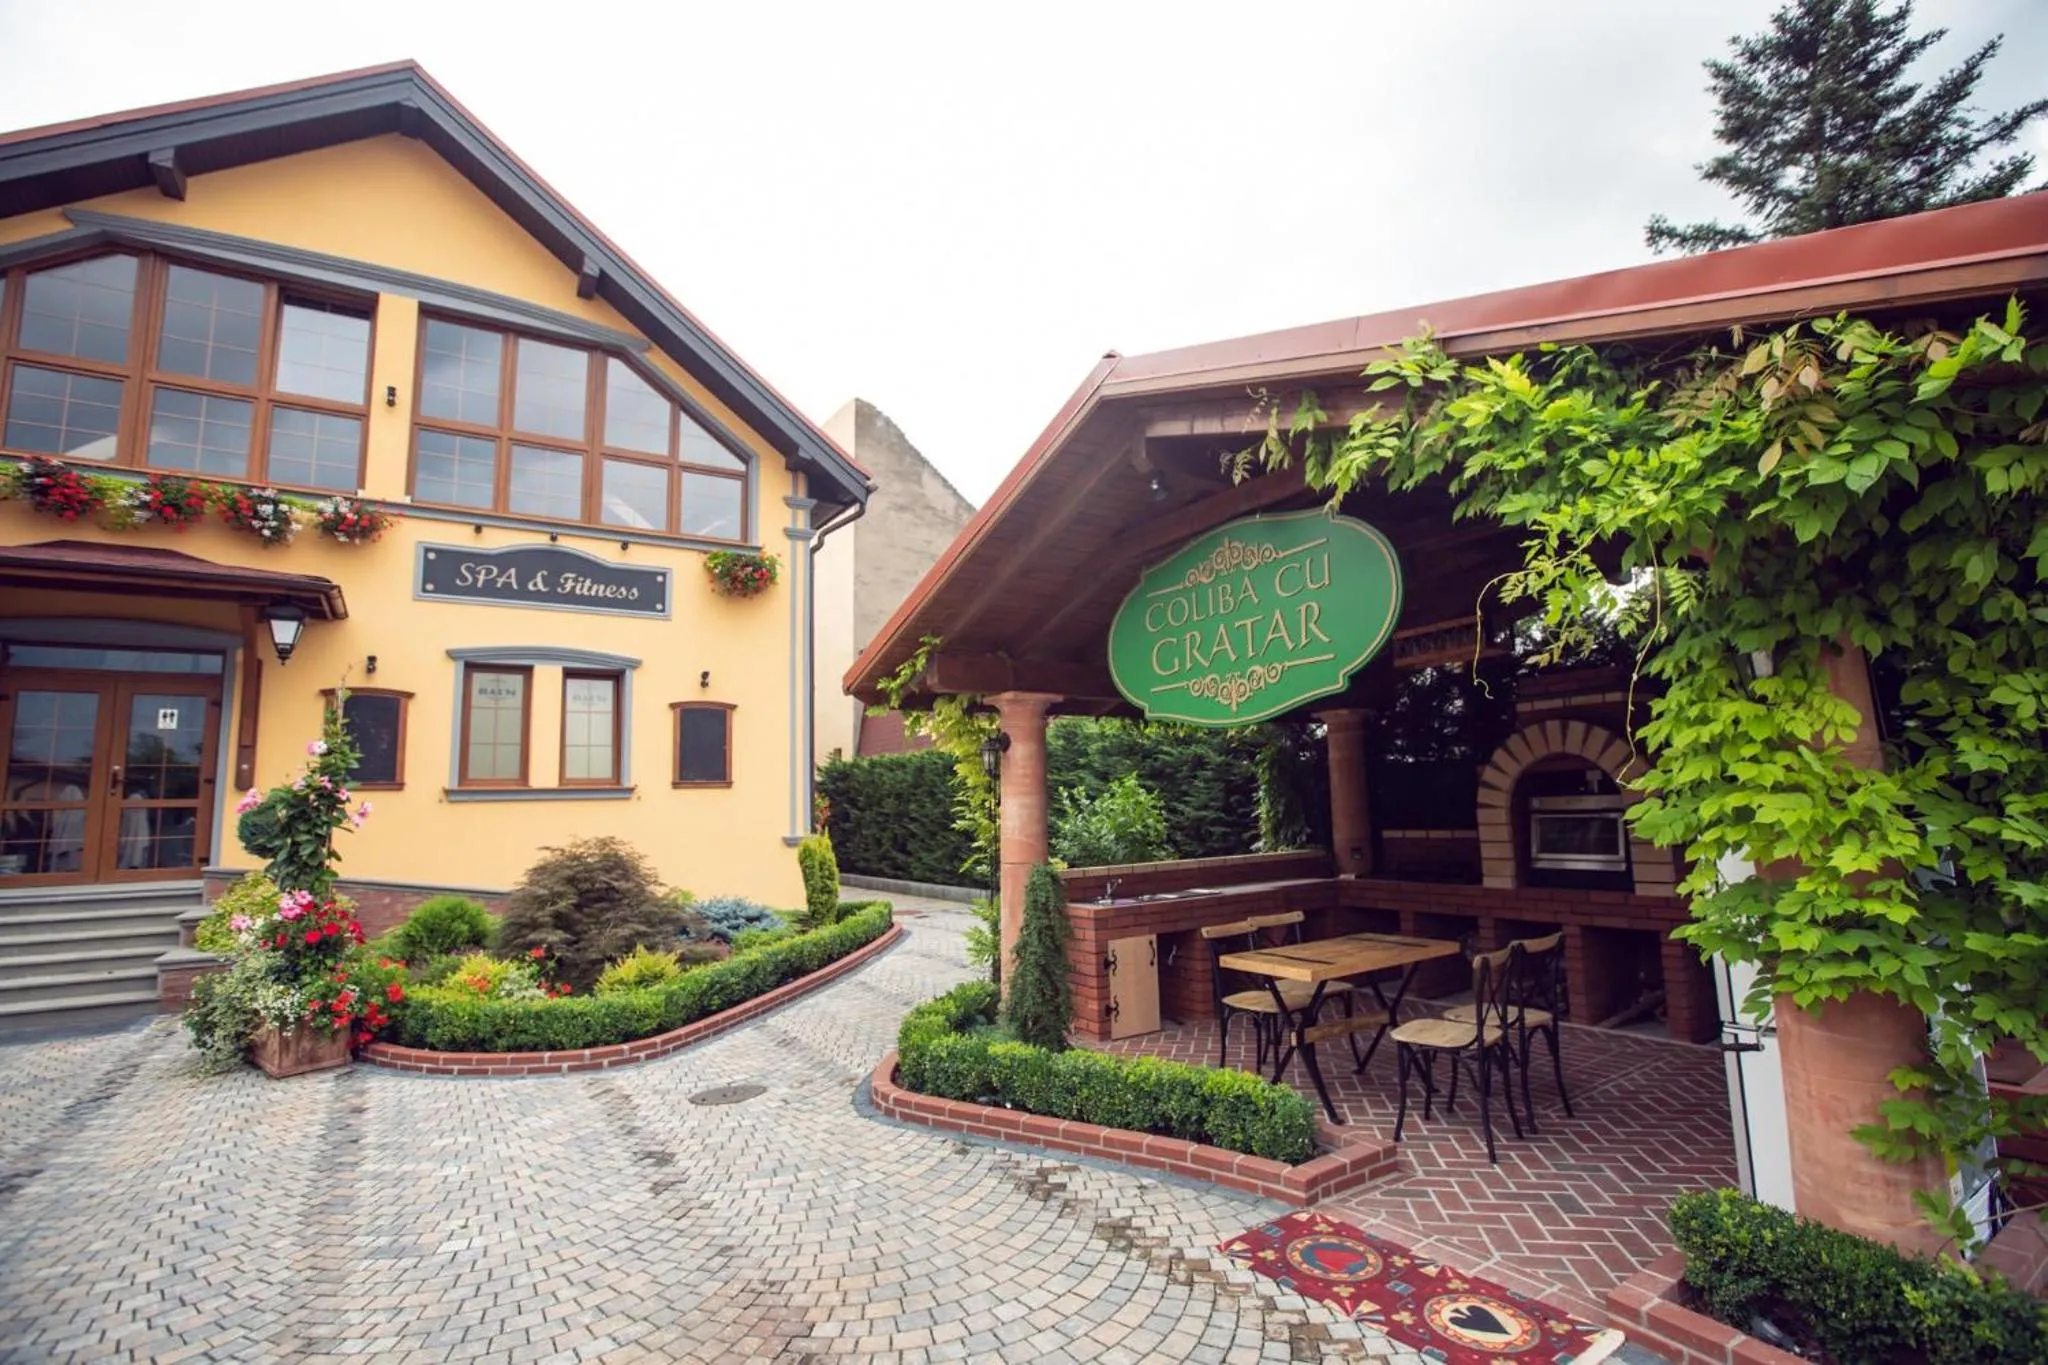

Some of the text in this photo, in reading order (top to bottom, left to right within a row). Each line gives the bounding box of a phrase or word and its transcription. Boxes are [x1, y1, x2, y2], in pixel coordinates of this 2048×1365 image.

[456, 562, 639, 600] SPA & Fitness
[1146, 553, 1332, 632] COLIBA CU
[1152, 601, 1332, 676] GRATAR
